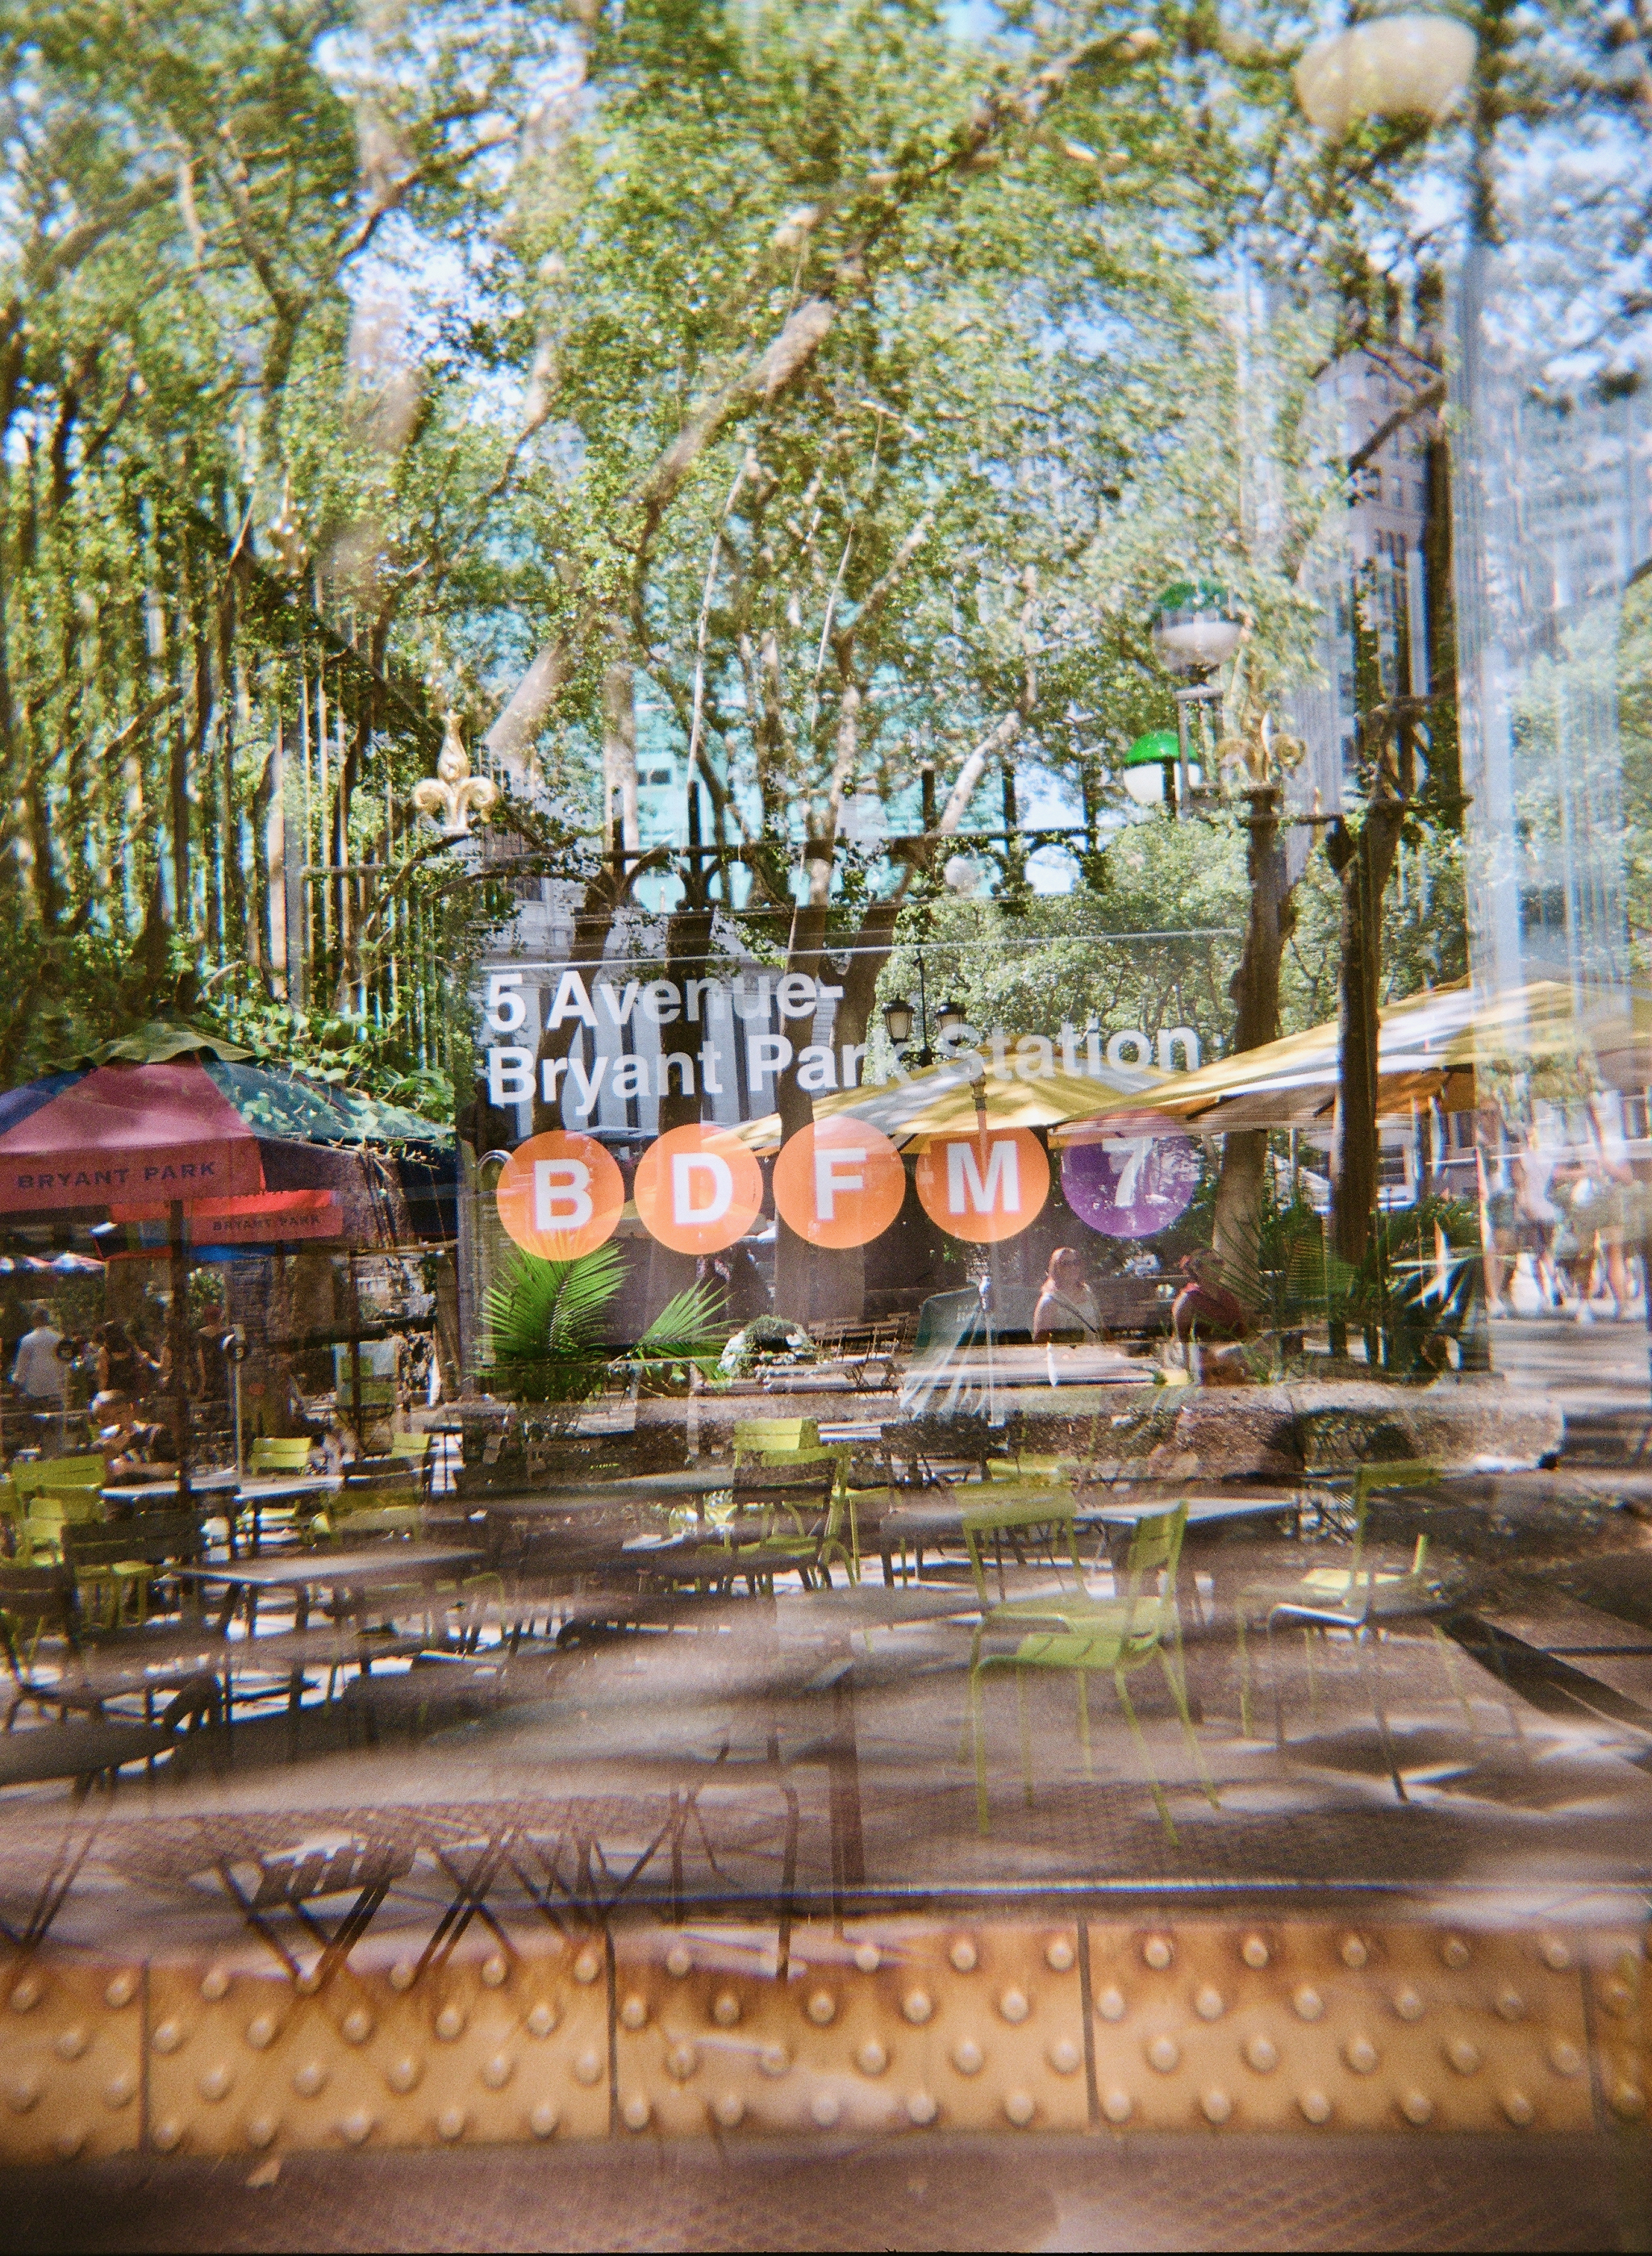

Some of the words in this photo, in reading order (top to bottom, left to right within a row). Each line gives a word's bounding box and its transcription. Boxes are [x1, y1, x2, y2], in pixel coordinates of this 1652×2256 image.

[487, 973, 526, 1032] 5
[547, 970, 844, 1029] Avenue-
[489, 1041, 723, 1116] Bryant
[748, 1034, 913, 1092] Park
[938, 1019, 1201, 1082] Station
[18, 1168, 129, 1189] BRYANT
[144, 1162, 215, 1181] PARK
[533, 1159, 594, 1230] B
[671, 1152, 733, 1225] D
[814, 1147, 867, 1220] F
[947, 1140, 1020, 1214] M
[1102, 1137, 1153, 1209] 7
